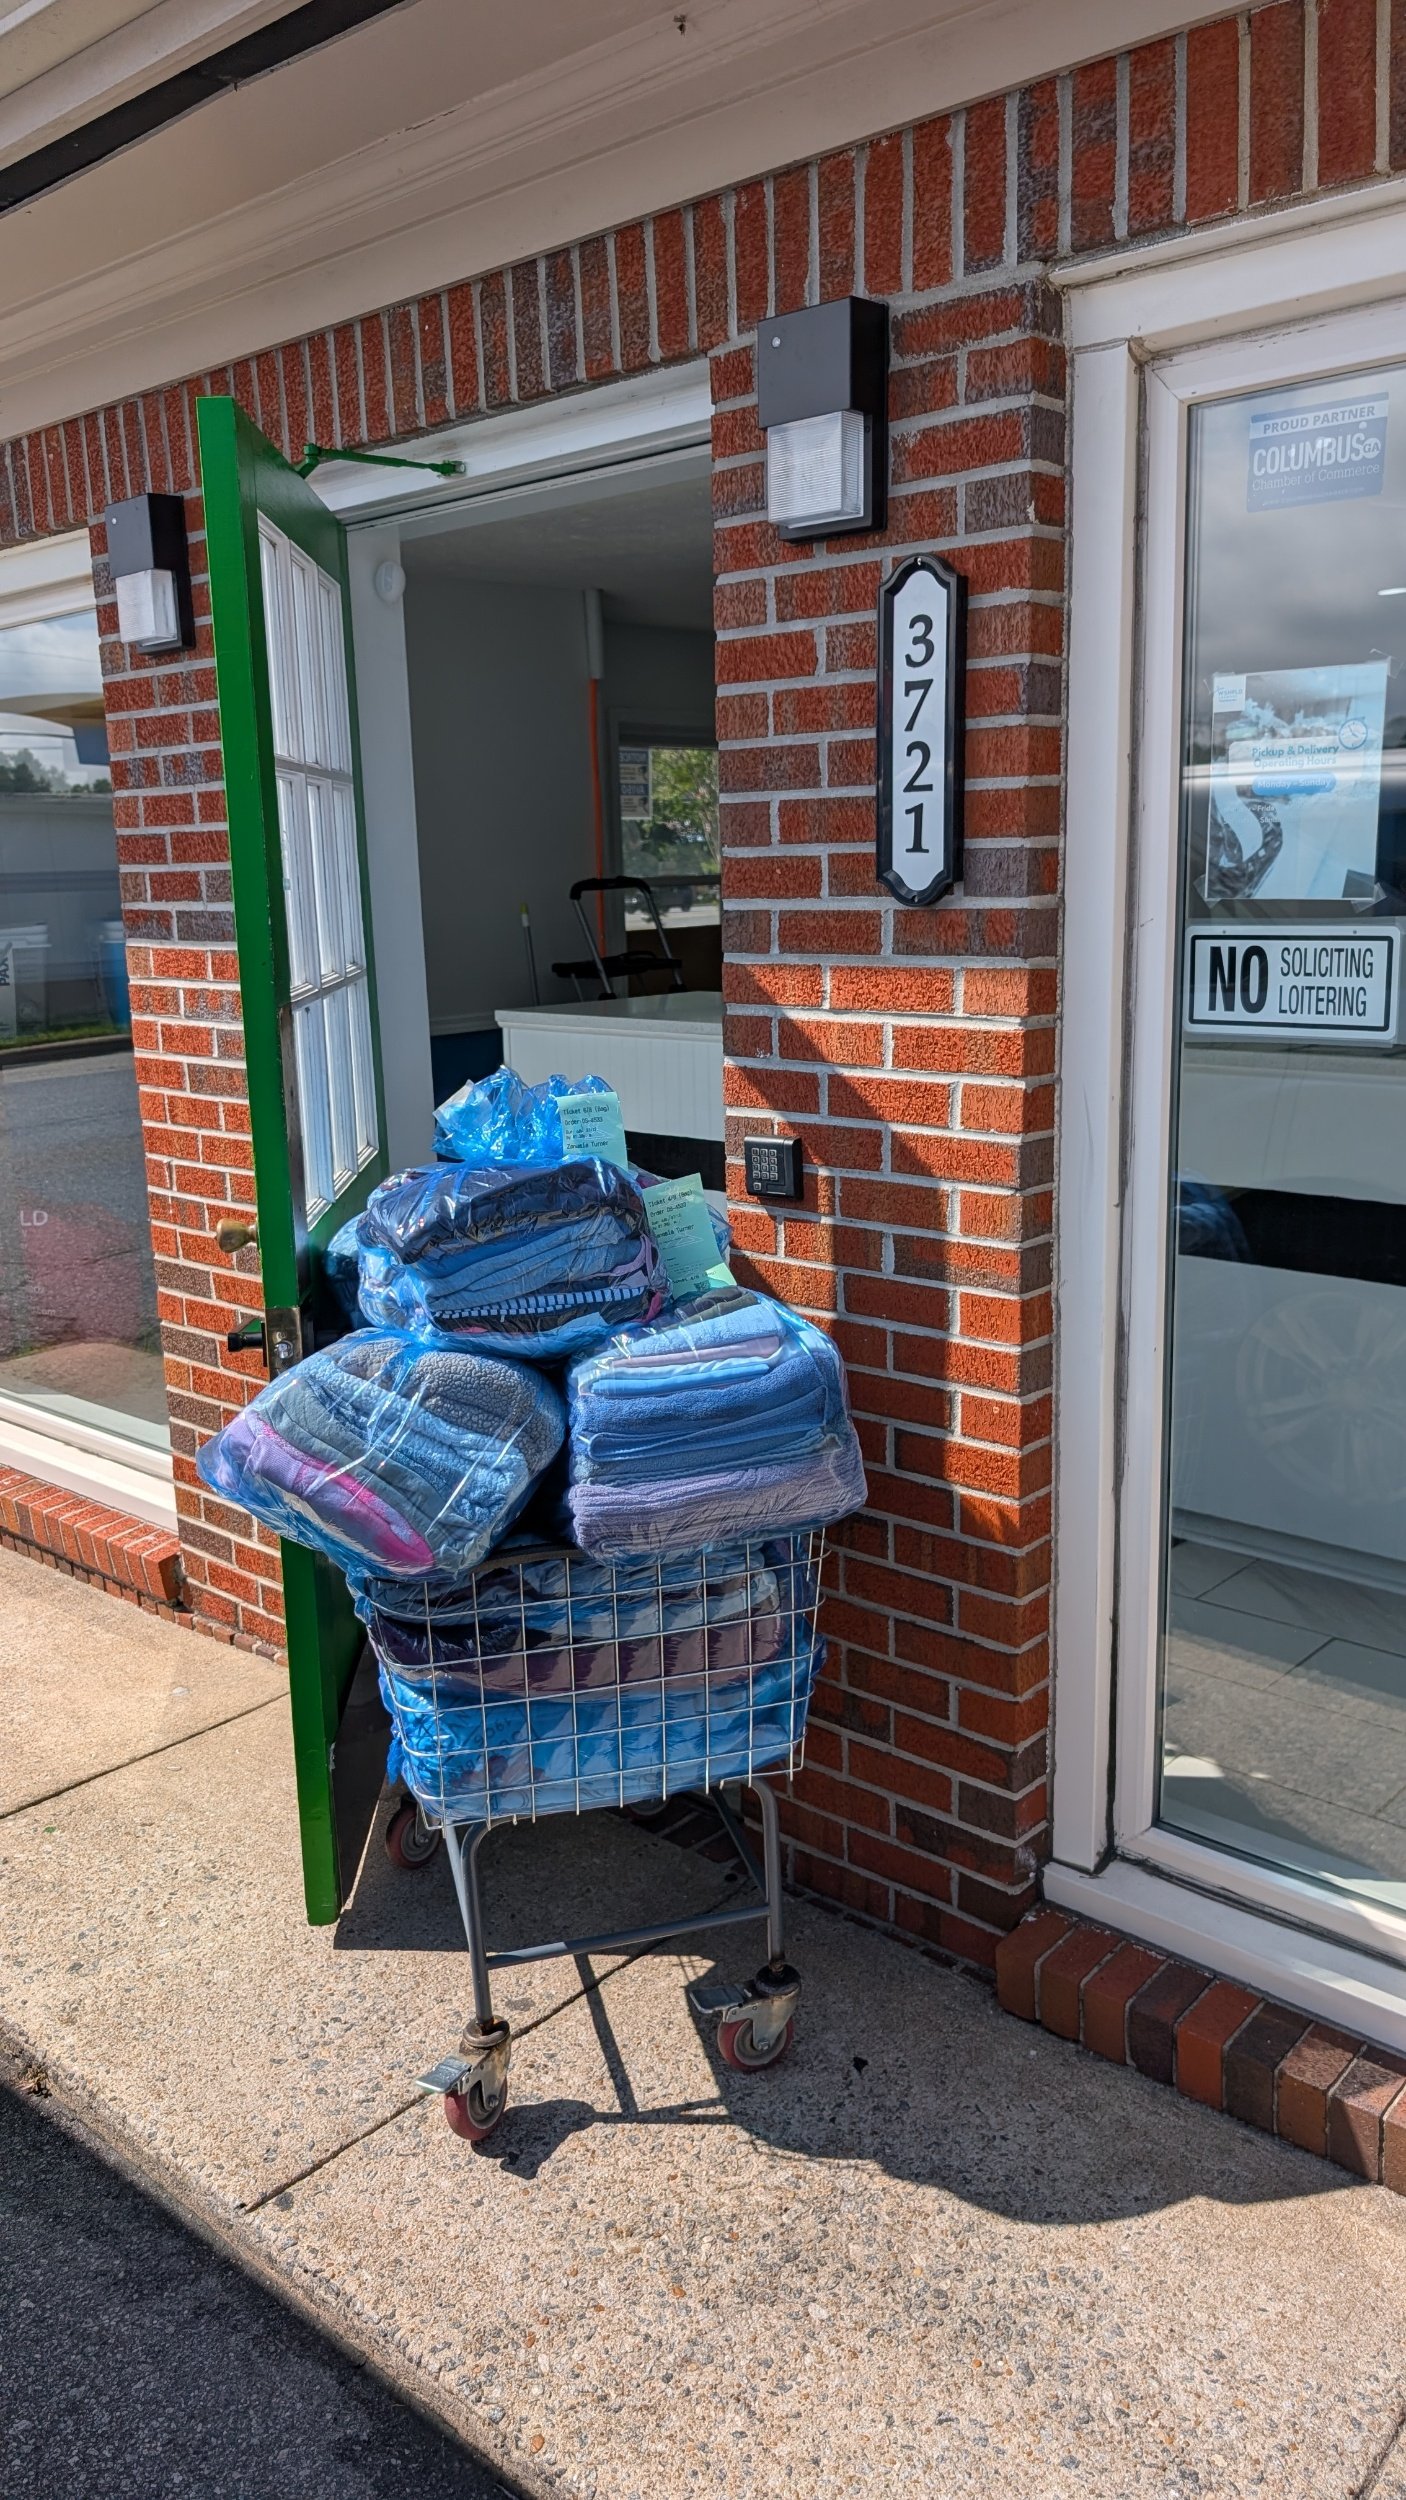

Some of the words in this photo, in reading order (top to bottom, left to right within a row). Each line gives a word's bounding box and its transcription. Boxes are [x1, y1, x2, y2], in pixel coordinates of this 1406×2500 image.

[1263, 418, 1309, 434] PROUD
[1313, 406, 1375, 426] PARTNER
[1253, 433, 1365, 476] COLUMBUS
[1363, 442, 1380, 453] GA
[1252, 475, 1301, 491] Chamber
[1305, 470, 1316, 483] of
[1319, 464, 1380, 482] Commerce
[903, 614, 935, 853] 3721
[1252, 747, 1284, 758] Pickup
[1287, 745, 1295, 755] &
[1298, 744, 1339, 755] Delivery
[1254, 757, 1304, 769] Operating
[1307, 756, 1337, 766] Hours
[1258, 780, 1290, 790] Monday
[1300, 778, 1331, 789] Sunday
[1208, 945, 1268, 1013] NO
[1281, 947, 1373, 978] SOLICITING
[1279, 985, 1367, 1016] LOITERING
[648, 1198, 666, 1207] Ticket
